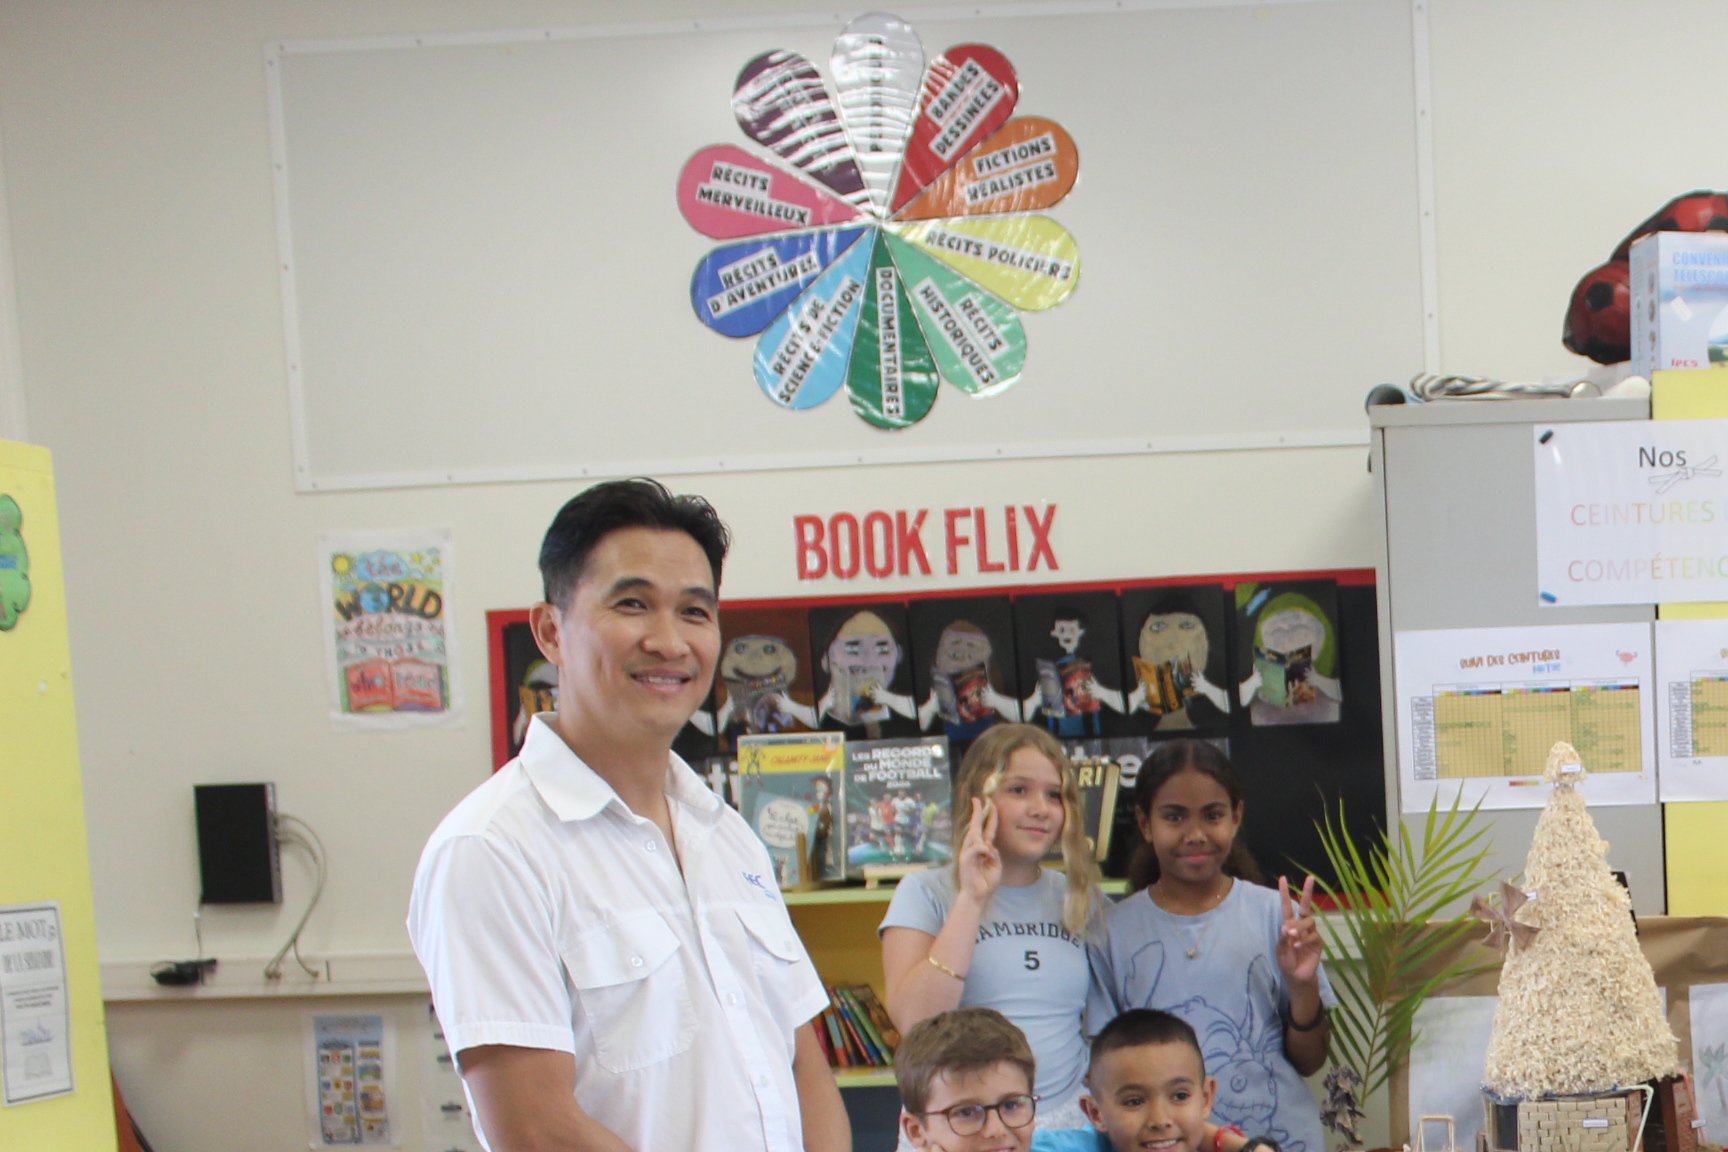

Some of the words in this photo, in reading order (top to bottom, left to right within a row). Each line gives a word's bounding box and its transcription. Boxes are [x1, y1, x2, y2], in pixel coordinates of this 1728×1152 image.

[931, 63, 979, 119] BANDES
[976, 137, 1051, 172] FICTIONS
[699, 186, 808, 224] MERVEILLEUX
[809, 298, 826, 320] DE
[778, 280, 861, 404] SCIENCE-FICTION
[879, 270, 900, 415] DOCUMENTAIRES
[920, 284, 994, 385] HISTORIQUES
[1639, 446, 1687, 468] Nos
[1571, 500, 1715, 526] CEINTURES
[793, 509, 932, 581] BOOK
[943, 503, 1060, 575] FLIX
[868, 768, 943, 782] FOOTBALL
[879, 757, 932, 771] MONDE
[975, 921, 1080, 948] AMBRIDGE
[1024, 951, 1040, 971] 5
